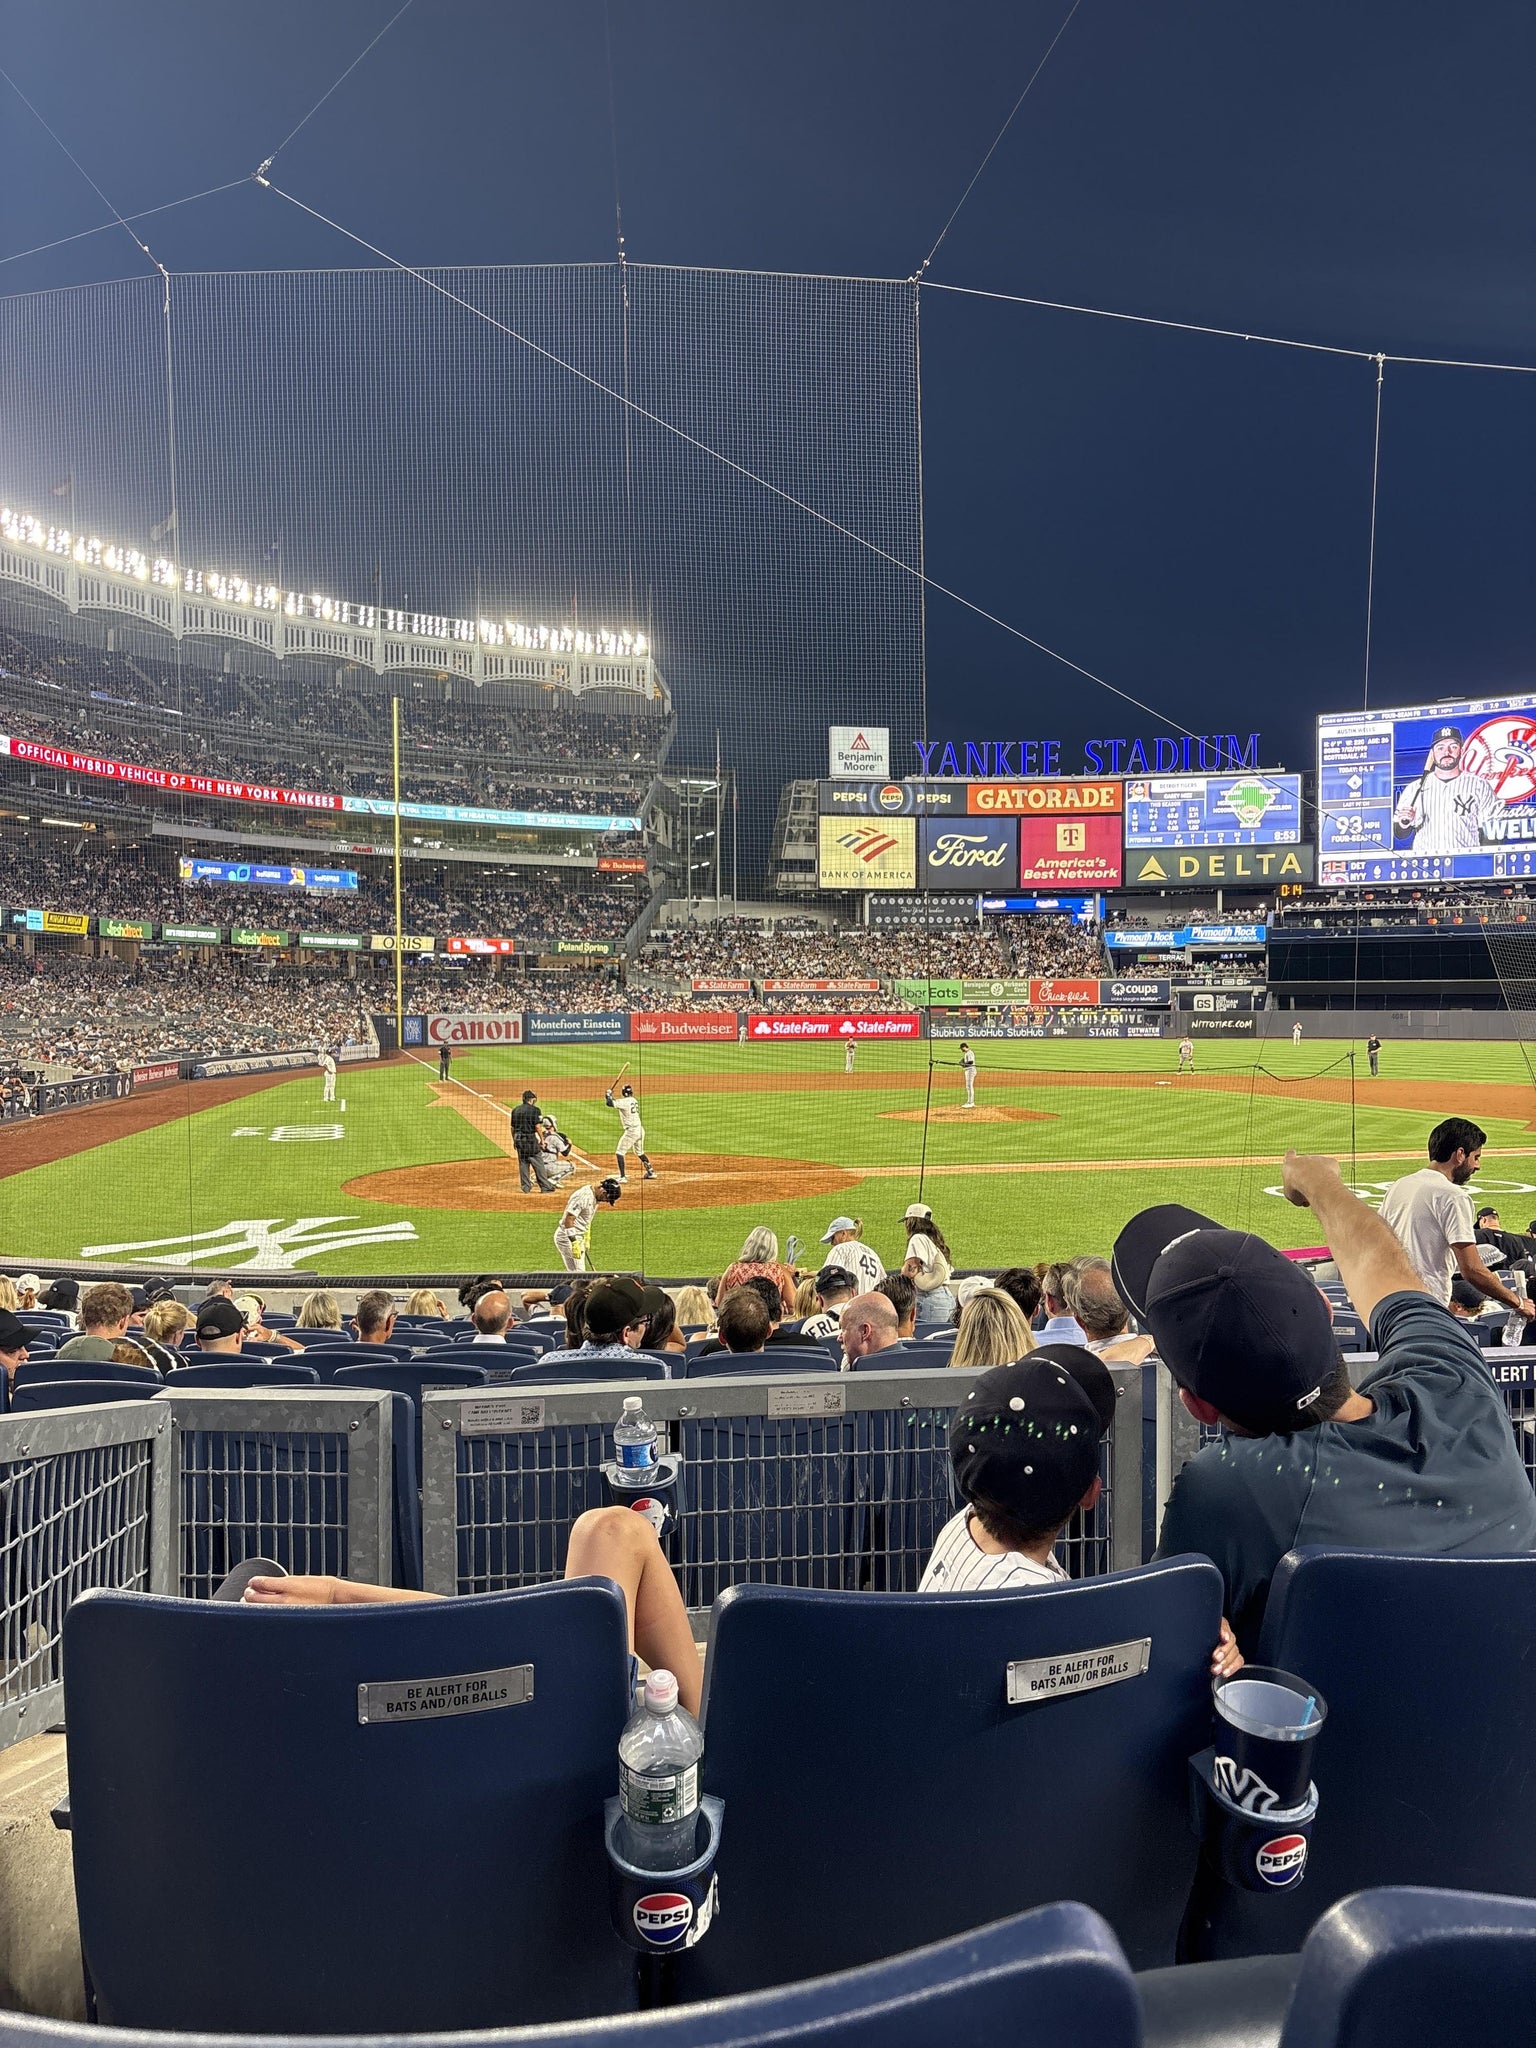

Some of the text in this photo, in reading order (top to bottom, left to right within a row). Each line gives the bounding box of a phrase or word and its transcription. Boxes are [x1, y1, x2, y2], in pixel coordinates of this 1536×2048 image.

[838, 752, 883, 762] Benjamin
[914, 733, 1260, 777] YANKEE STADIUM
[844, 762, 875, 771] Moore
[18, 742, 69, 765] OFFICIAL
[72, 755, 115, 774] HYBRID
[119, 767, 166, 785] VEHICLE
[170, 776, 186, 787] OF
[190, 778, 212, 791] THE
[217, 782, 243, 796] NEW
[246, 787, 278, 800] YORK
[283, 791, 335, 808] YANKEES
[833, 792, 867, 802] PEPSI
[917, 794, 951, 803] PEPSI
[976, 788, 1114, 809] GATORADE
[1336, 815, 1380, 834] 93 MPH
[1482, 818, 1536, 840] WEL
[1274, 831, 1295, 841] 8:53
[1331, 834, 1372, 843] FOUR-SEAM
[352, 846, 372, 854] Audi
[928, 834, 1008, 867] Ford
[1035, 857, 1106, 869] America's
[1179, 853, 1302, 878] DELTA
[1350, 862, 1366, 870] DET
[1391, 860, 1395, 868] 1
[1401, 860, 1408, 868] 4
[1423, 859, 1429, 867] 2
[1497, 855, 1503, 864] 7
[1510, 854, 1517, 863] 9
[1523, 853, 1530, 862] 0
[822, 871, 912, 879] BANK OF AMERICA
[1024, 868, 1118, 880] Best Network
[1350, 873, 1366, 881] NYY
[1390, 871, 1396, 879] 0
[1401, 871, 1407, 879] 0
[1412, 870, 1418, 879] 0
[1433, 869, 1440, 878] 0
[1497, 866, 1503, 875] 0
[1511, 866, 1516, 874] 1
[1523, 865, 1530, 873] 2
[1281, 884, 1302, 897] 0:14
[106, 920, 143, 938] freshdirect
[1191, 926, 1257, 940] Plymouth Rock
[237, 930, 280, 946] freshdirect
[383, 936, 422, 949] ORIS
[1115, 931, 1175, 944] Plymouth Rock
[558, 942, 609, 954] Poland Spring
[901, 987, 959, 998] Uber Eats
[1126, 985, 1158, 996] coupa
[1197, 1000, 1211, 1008] GS
[430, 1017, 520, 1041] Canon
[531, 1018, 621, 1029] Montefiore Einstein
[407, 1032, 419, 1040] LIFE
[931, 1028, 1044, 1037] StubHub StubHub StubHub
[1089, 1028, 1119, 1037] STARR
[859, 1254, 877, 1278] 45
[1491, 1366, 1529, 1382] LERT
[1049, 1655, 1114, 1675] BE ALERT FOR
[1031, 1662, 1128, 1690] BATS AND/OR BALLS
[407, 1680, 487, 1699] BE ALERT FOR
[387, 1689, 507, 1712] BATS AND/OR BALLS
[1261, 1849, 1304, 1866] PEPSI
[637, 1909, 689, 1925] PEPSI
